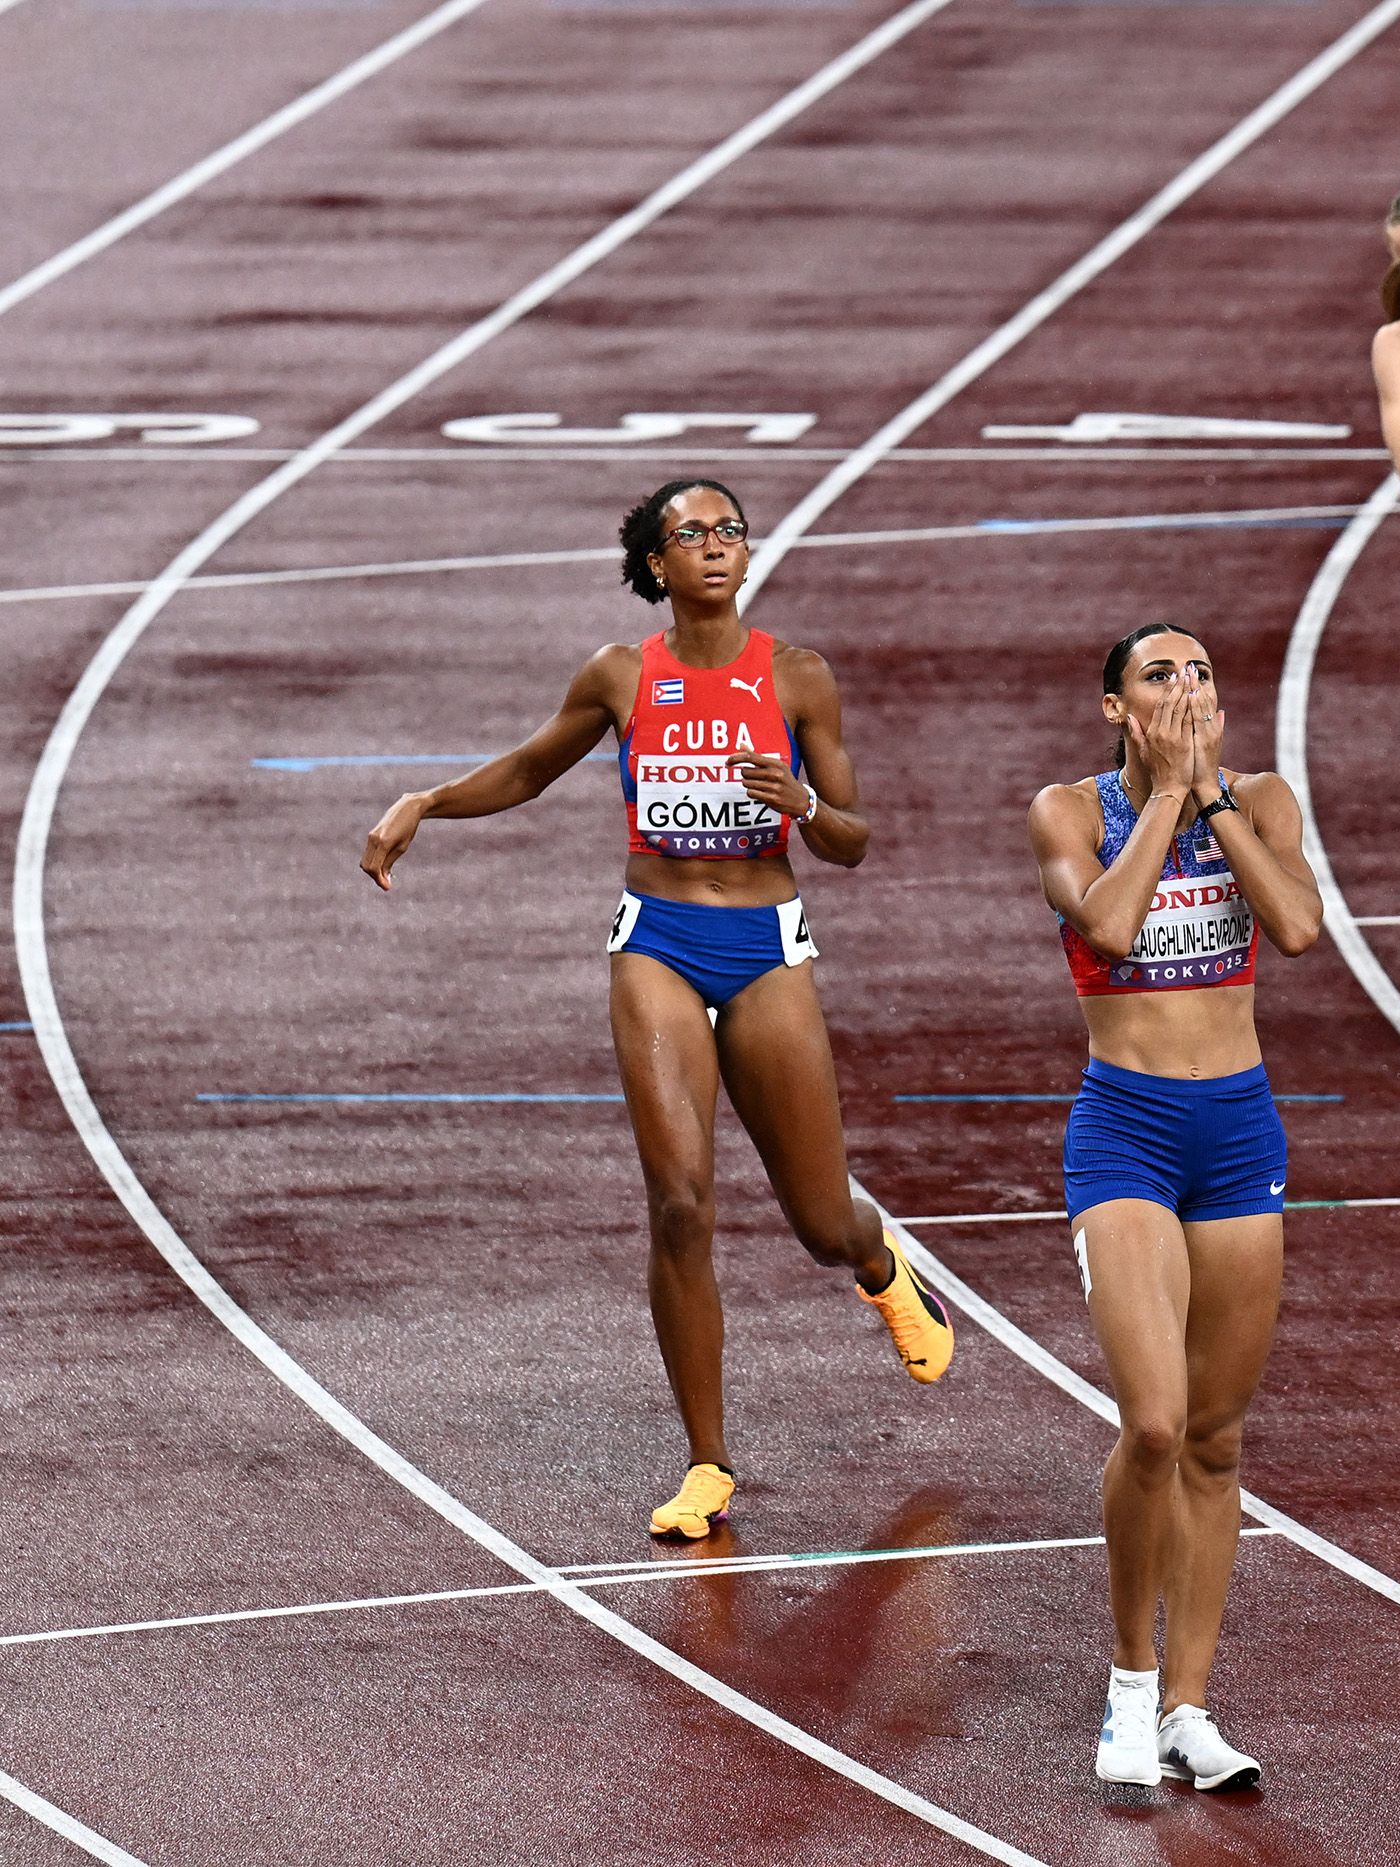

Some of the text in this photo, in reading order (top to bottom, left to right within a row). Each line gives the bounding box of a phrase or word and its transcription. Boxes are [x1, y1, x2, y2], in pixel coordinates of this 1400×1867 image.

[441, 412, 815, 443] 5
[981, 412, 1351, 443] 4
[663, 719, 755, 753] CUBA
[641, 765, 744, 783] HOND
[647, 795, 773, 829] GÓMEZ
[1149, 882, 1243, 912] ONDA
